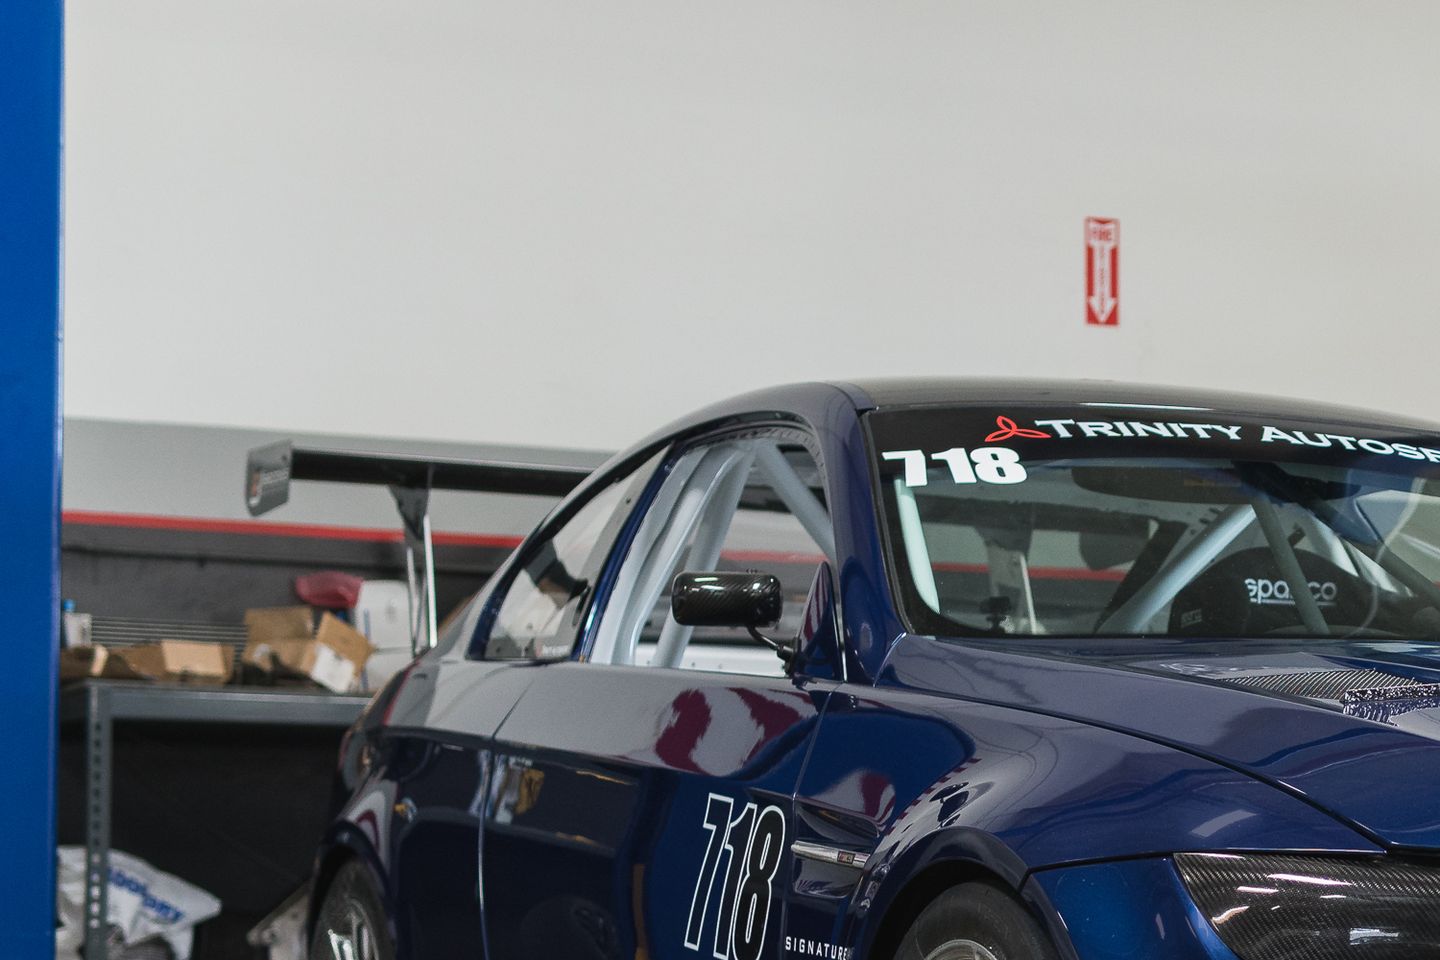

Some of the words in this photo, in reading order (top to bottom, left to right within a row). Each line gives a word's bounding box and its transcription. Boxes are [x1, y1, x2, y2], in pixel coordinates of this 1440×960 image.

[1034, 418, 1242, 441] TRINITY
[882, 446, 1028, 488] 718
[1244, 578, 1337, 605] spaco
